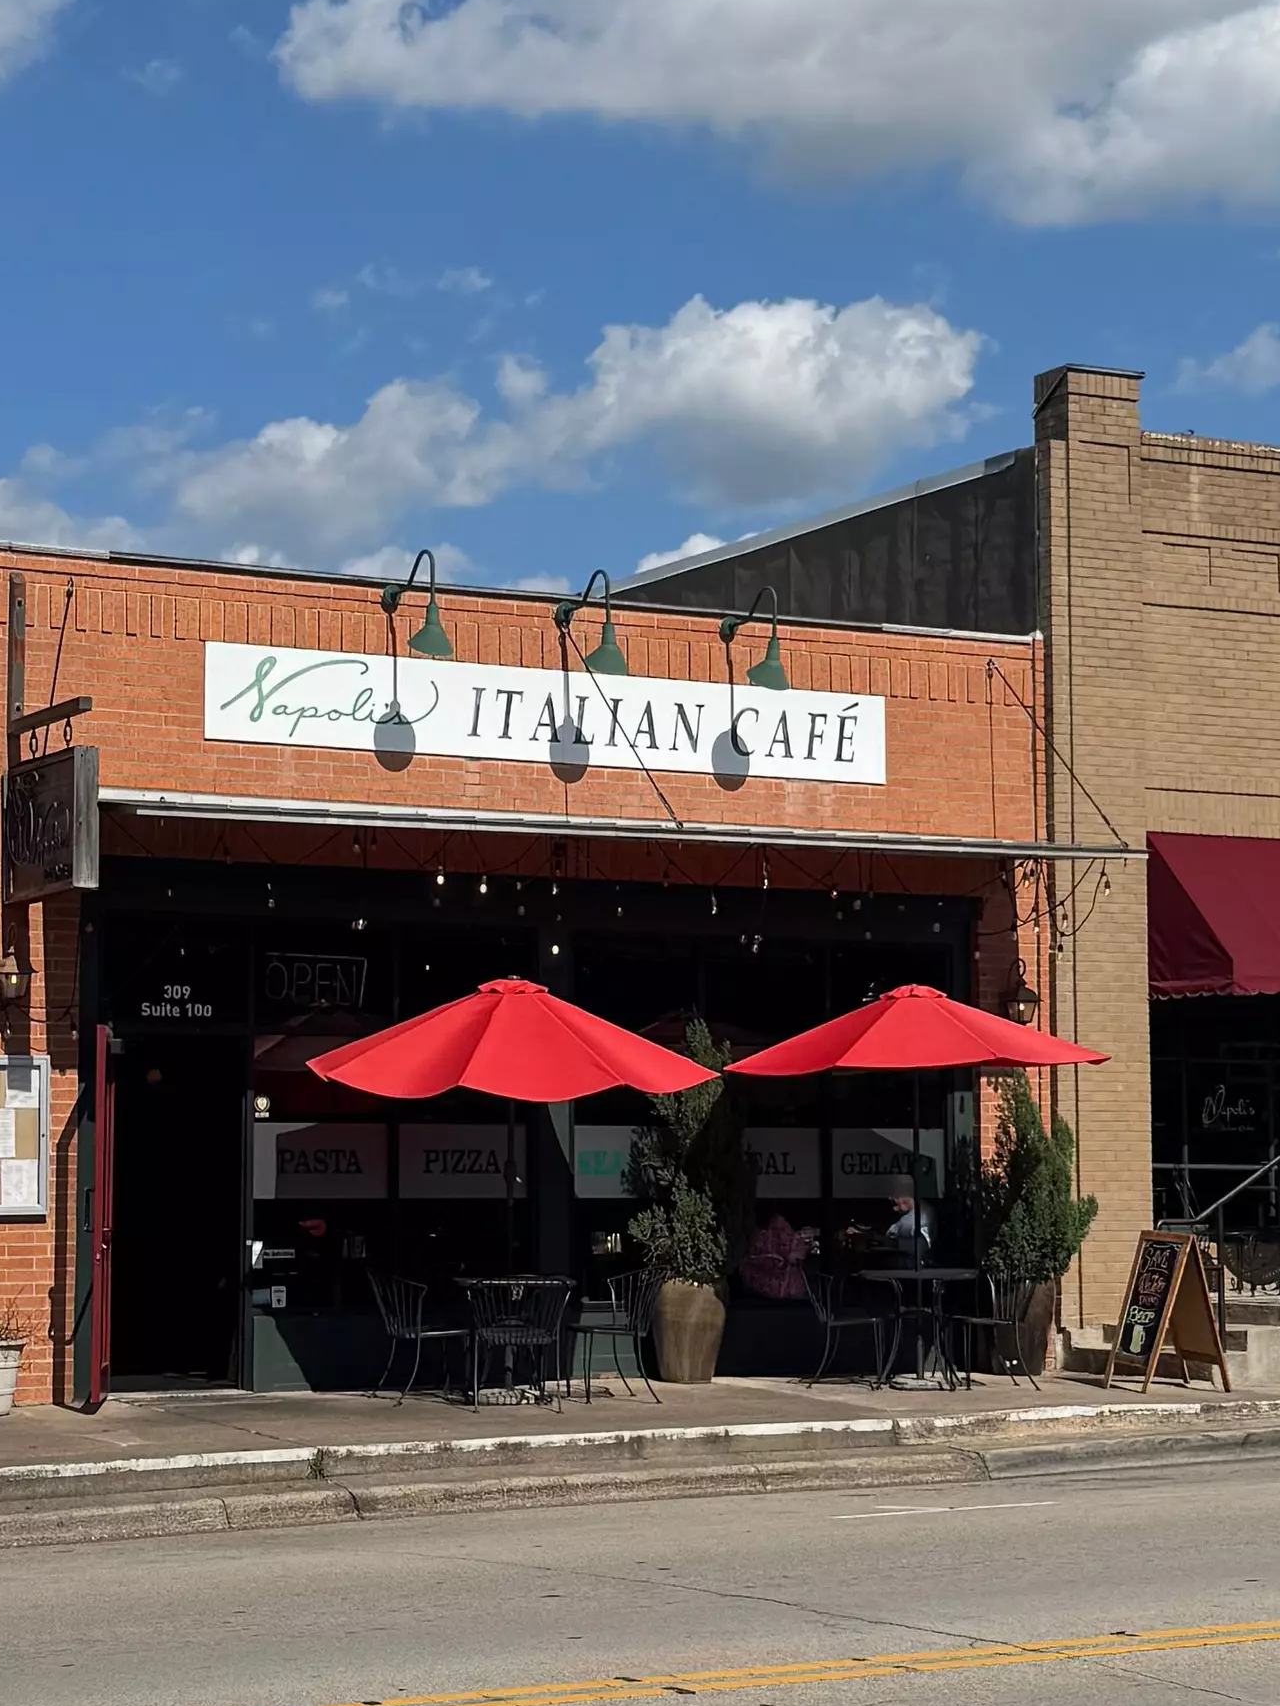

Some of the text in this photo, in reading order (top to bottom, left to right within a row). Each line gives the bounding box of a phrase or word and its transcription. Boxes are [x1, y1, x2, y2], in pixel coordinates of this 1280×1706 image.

[220, 655, 861, 763] Napoli's ITALIAN CAFÉ
[162, 984, 192, 1001] 309
[264, 960, 358, 1007] OPEN
[140, 1001, 213, 1018] Suite 100
[278, 1148, 363, 1174] PASTA
[422, 1149, 502, 1174] PIZZA
